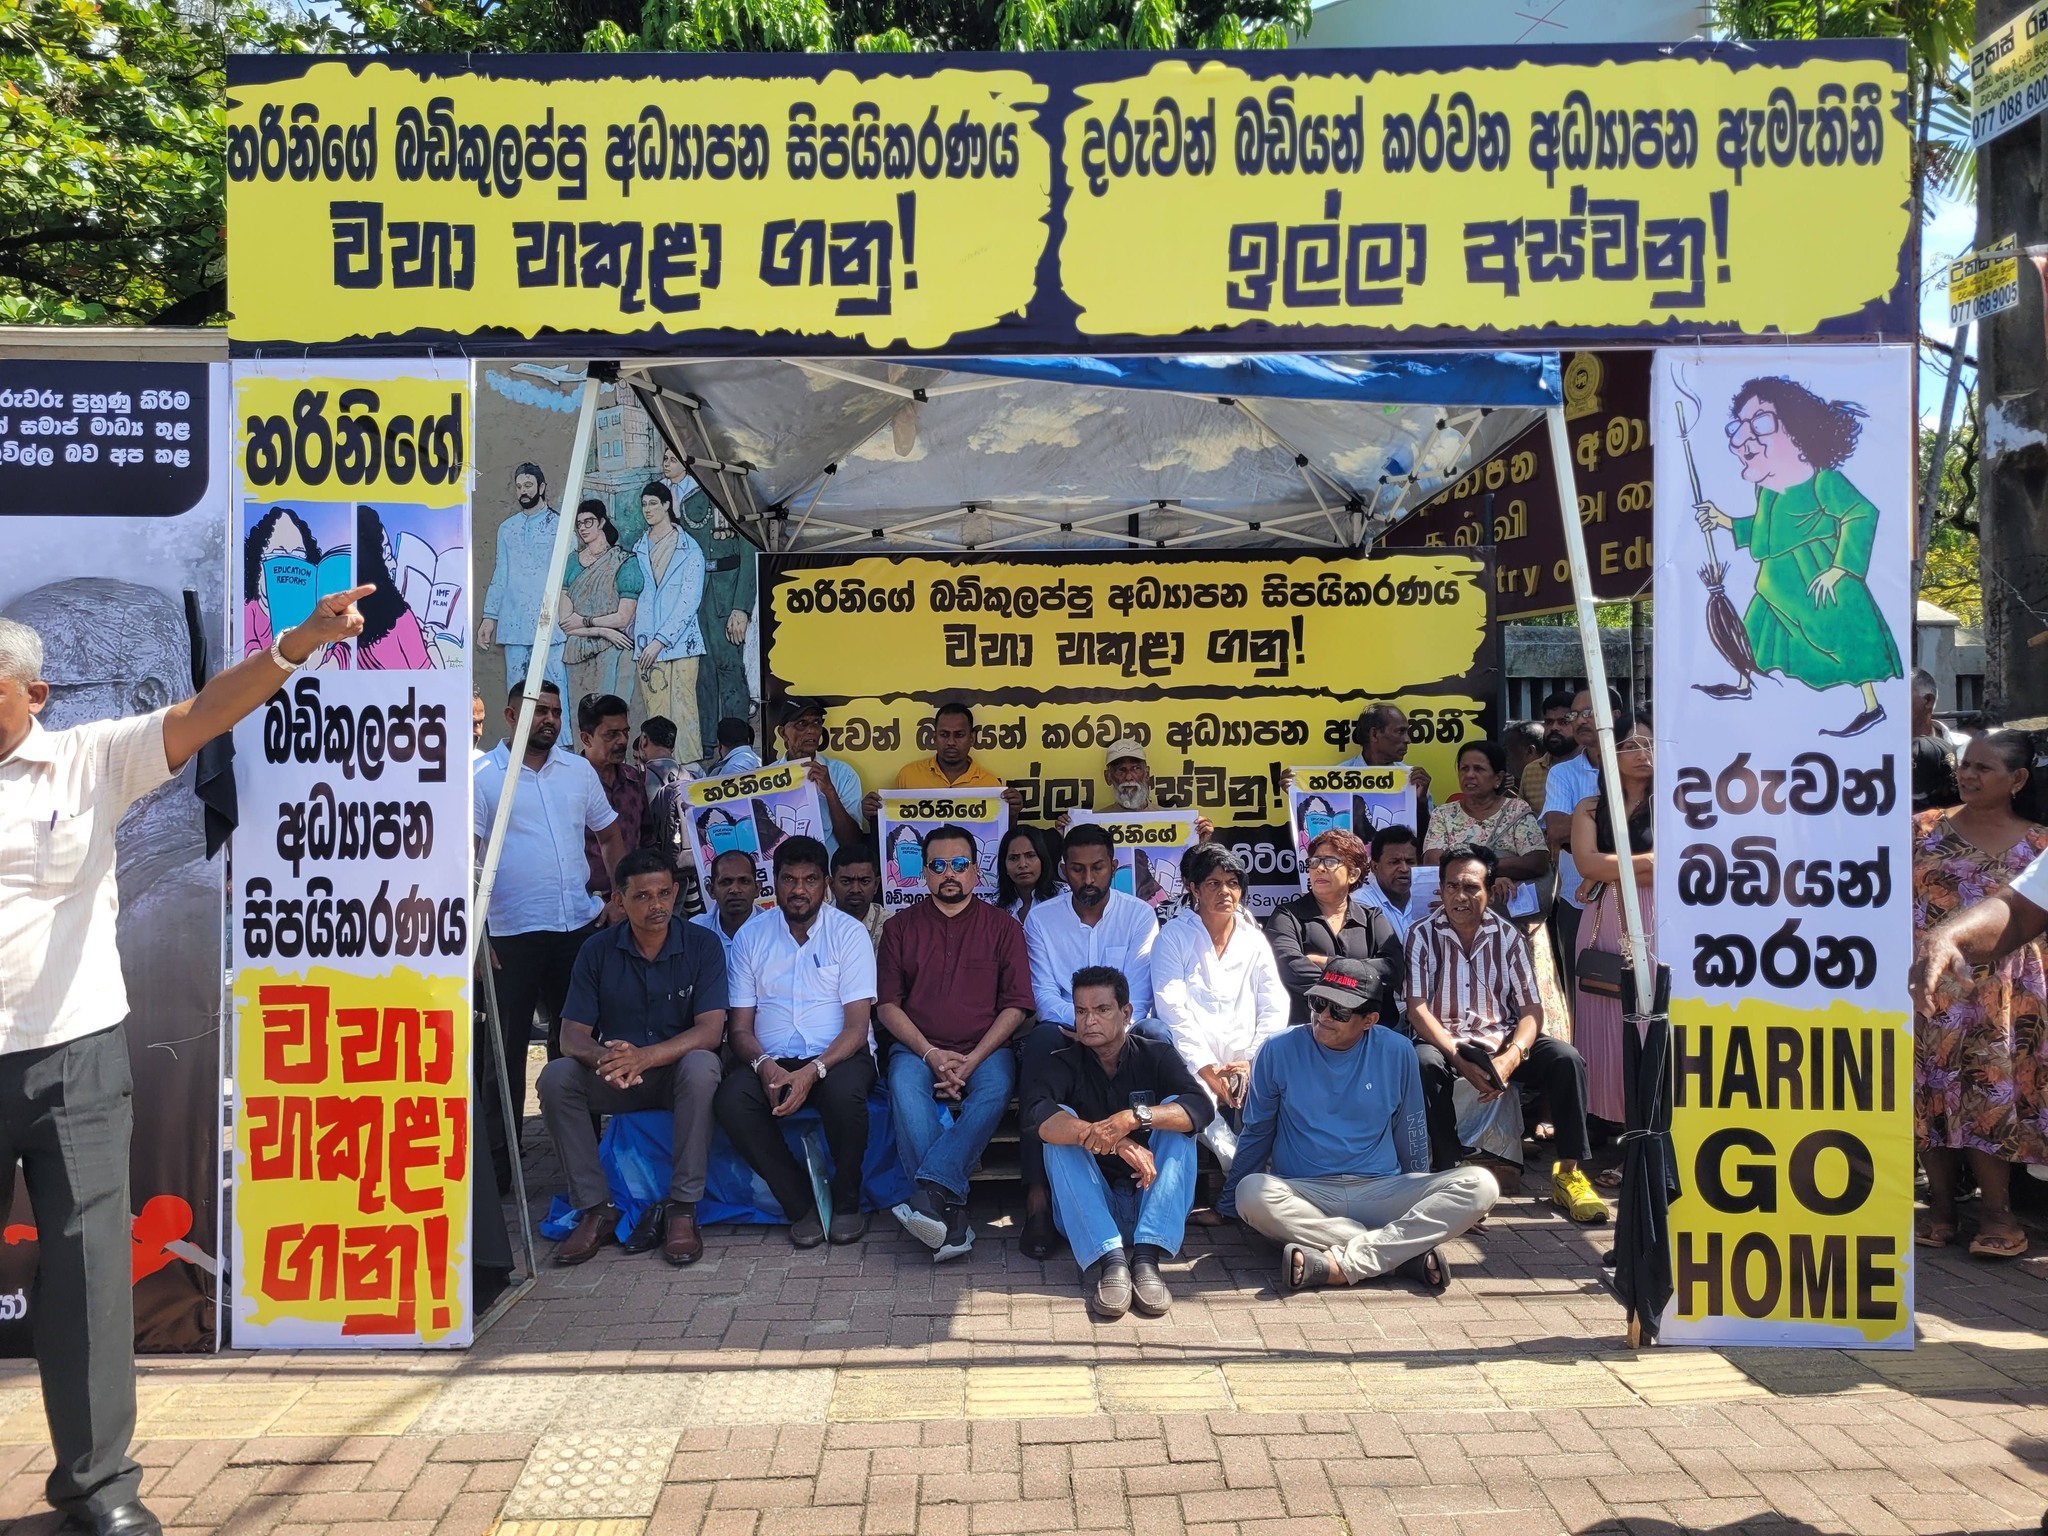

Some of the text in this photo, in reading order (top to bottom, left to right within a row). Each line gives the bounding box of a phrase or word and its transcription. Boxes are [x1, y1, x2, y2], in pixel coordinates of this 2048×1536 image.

[1082, 81, 1885, 197] දරුවන් බඩියන් කරවන අධ්‍යාපන ඇමැතිනී
[1972, 106, 1996, 141] 077
[1999, 90, 2023, 126] 088
[227, 96, 1020, 200] හරිනිගේ බඩිකුලප්පු අධ්‍යාපන සිපයිකරණය
[330, 190, 919, 317] වහා හකුළා ගනු!
[1226, 184, 1733, 312] ඉල්ලා අස්වනු!
[1951, 300, 1971, 324] 077
[20, 416, 80, 437] සමාජ
[90, 416, 144, 437] මාධ්‍ය
[155, 421, 192, 442] තුළ
[72, 391, 132, 414] පුහුණු
[0, 440, 191, 467] විල්ල බව අප කළ
[246, 388, 464, 487] හරිනිගේ
[1576, 416, 1647, 472] අමා
[273, 565, 312, 578] EDUCATION
[276, 575, 307, 586] REFORMS
[436, 588, 450, 598] IMF
[787, 572, 1460, 619] හරිනිගේ බඩිකුලප්පු අධ්‍යාපන සිපයිකරණය
[1496, 561, 1541, 598] try
[1553, 559, 1570, 583] o
[432, 599, 449, 608] PLAN
[944, 615, 1305, 677] වහා හකුළා ගනු!
[264, 677, 447, 782] බඩිකුලප්පු
[1041, 714, 1152, 749] කරවන
[1166, 712, 1310, 754] අධ්‍යාපන
[703, 768, 793, 802] හරිනිගේ
[899, 799, 987, 819] හරිනිගේ
[1309, 770, 1395, 791] හරිනිගේ
[1673, 752, 1896, 830] දරුවන්
[277, 782, 434, 878] අධ්‍යාපන
[1110, 823, 1177, 844] රිනිගේ
[1678, 836, 1892, 908] බඩියන්
[243, 876, 467, 958] සිපයිකරණය
[1693, 918, 1877, 989] කරන
[259, 985, 454, 1085] වහා
[1673, 1024, 1895, 1112] HARINI
[245, 1095, 468, 1215] හකුළා
[1694, 1127, 1875, 1216] GO
[261, 1214, 451, 1336] ගනු!
[1677, 1231, 1898, 1320] HOME
